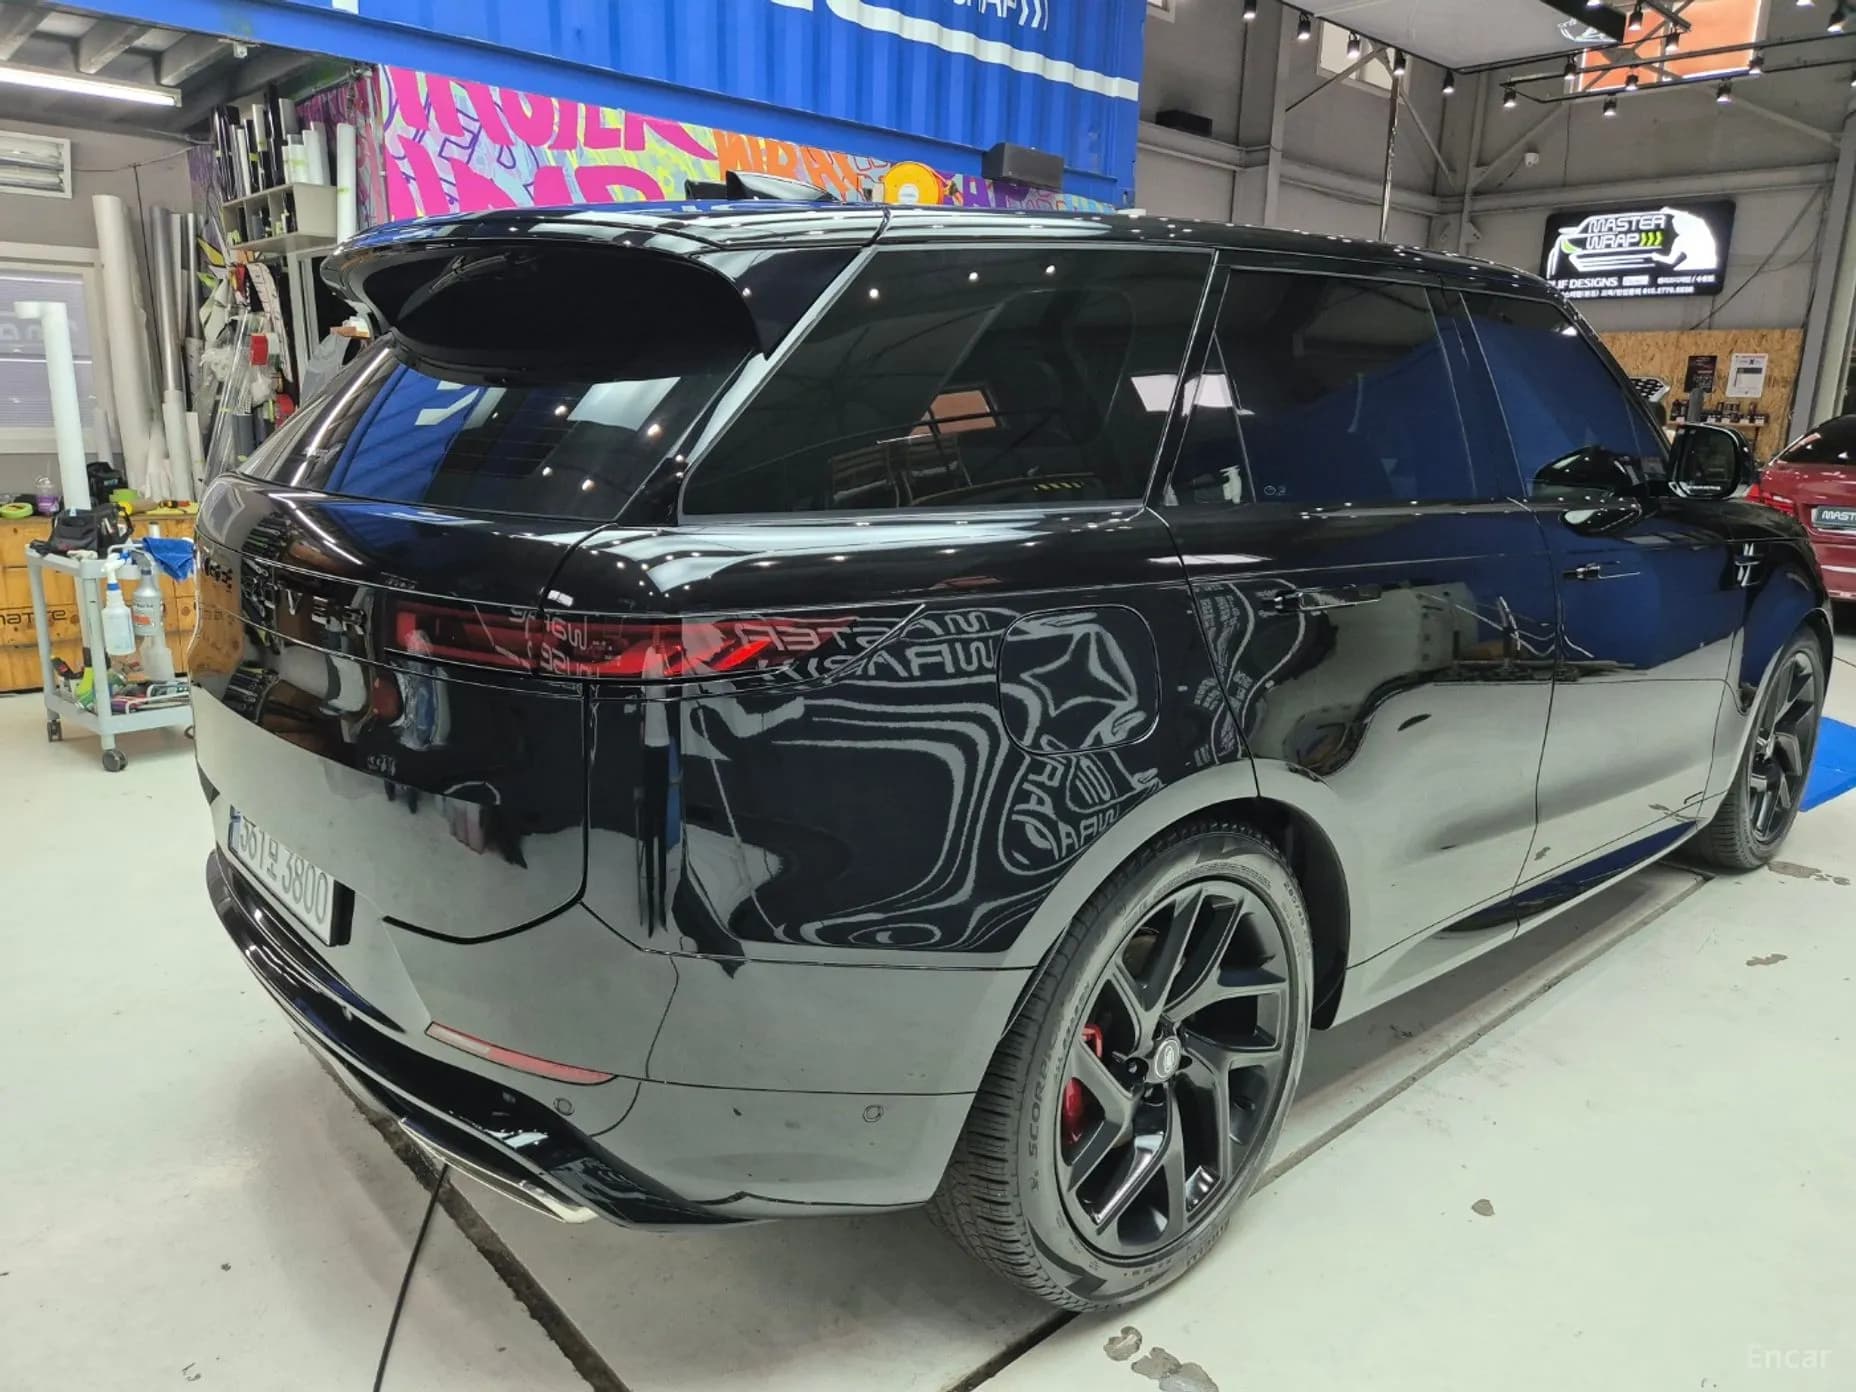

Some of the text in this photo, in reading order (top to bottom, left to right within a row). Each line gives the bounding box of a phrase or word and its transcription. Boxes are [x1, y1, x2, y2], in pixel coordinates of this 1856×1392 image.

[1588, 215, 1666, 233] MASTER
[1585, 232, 1639, 249] WRAP
[1569, 277, 1618, 289] DESIGNS
[281, 850, 329, 925] 3800
